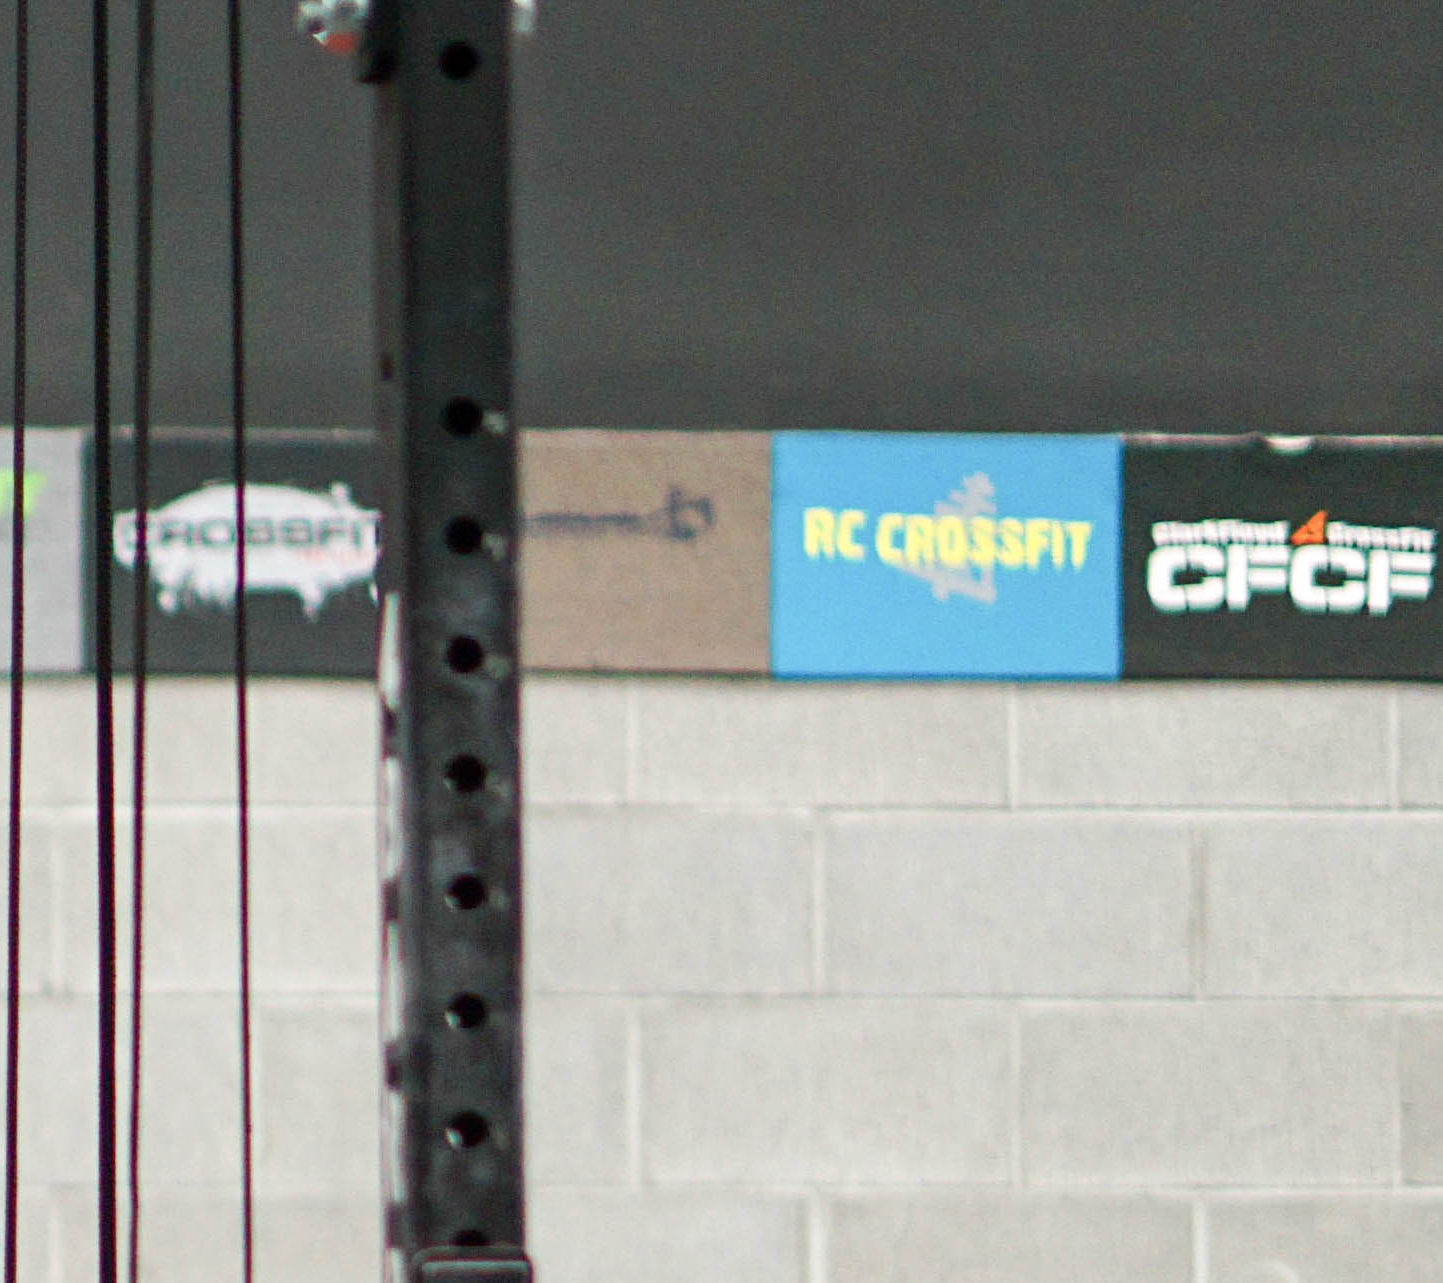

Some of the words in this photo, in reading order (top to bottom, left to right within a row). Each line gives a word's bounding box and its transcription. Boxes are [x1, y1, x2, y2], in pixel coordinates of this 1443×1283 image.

[121, 515, 376, 547] CROSSFI
[803, 507, 867, 561] RC
[876, 512, 1092, 570] CROSSFIT
[1146, 544, 1436, 616] CFCF
